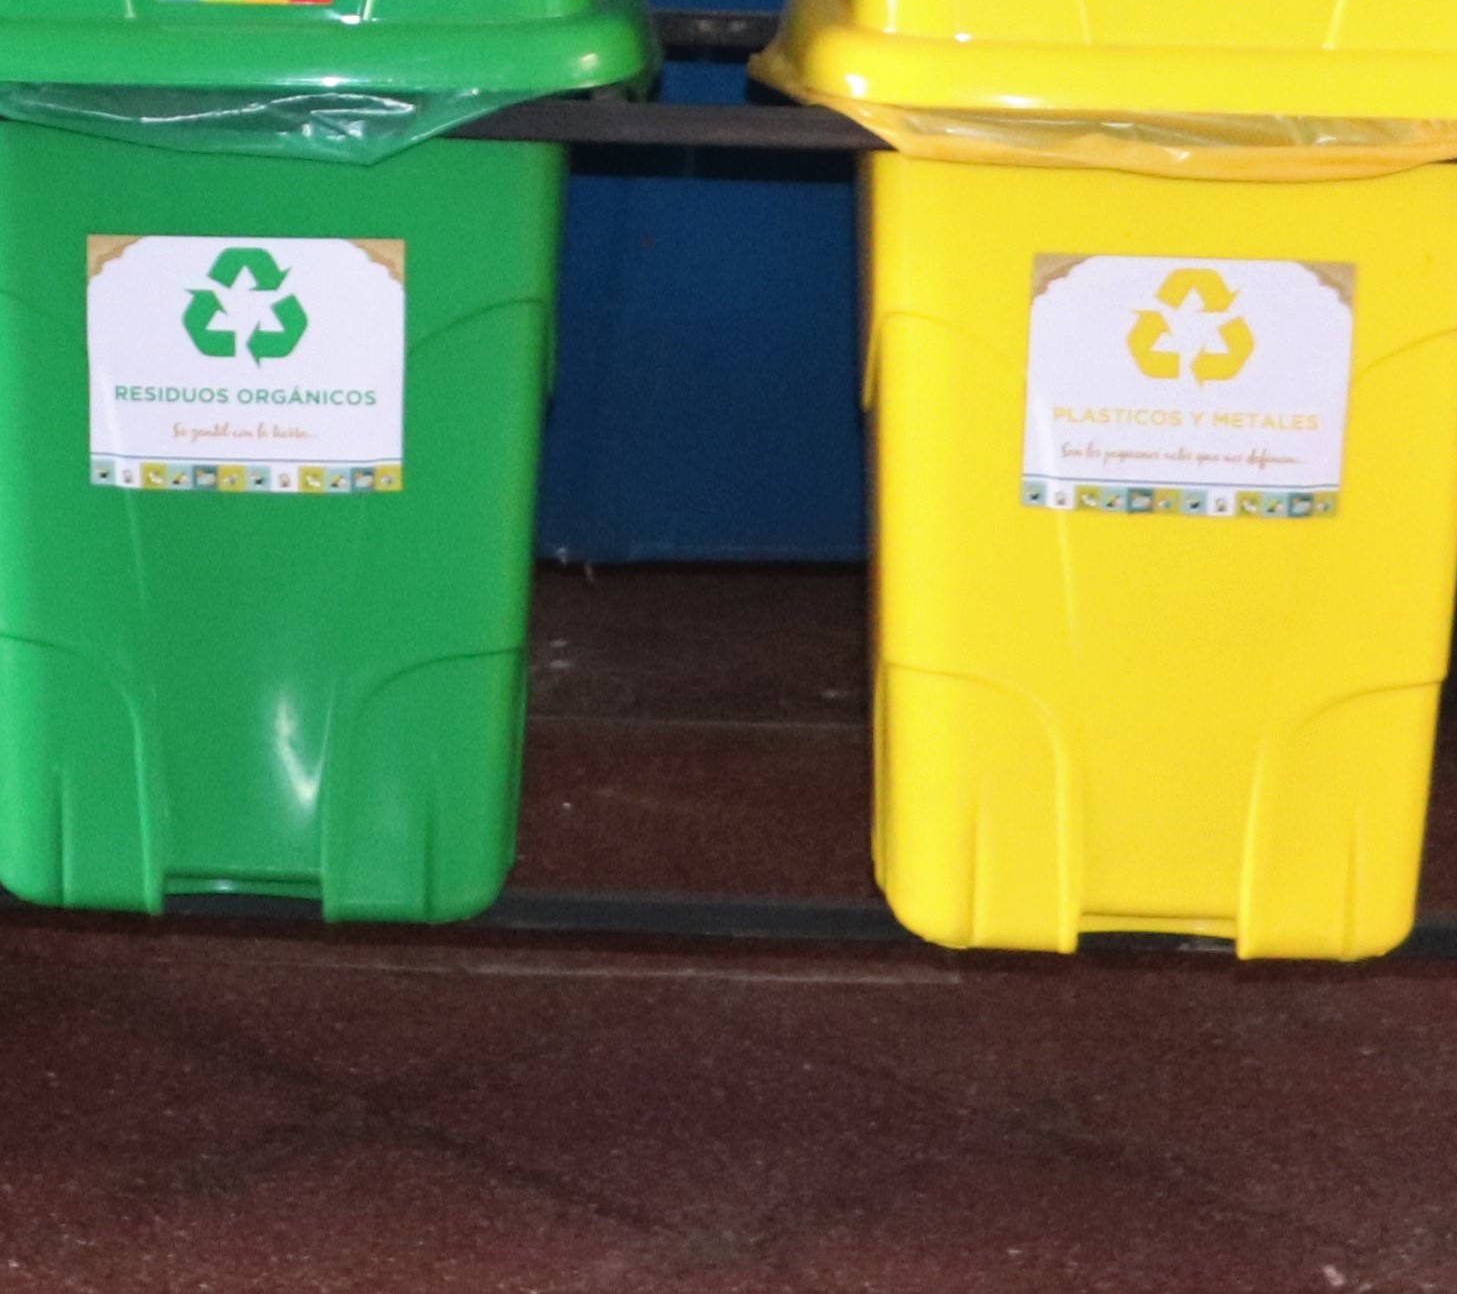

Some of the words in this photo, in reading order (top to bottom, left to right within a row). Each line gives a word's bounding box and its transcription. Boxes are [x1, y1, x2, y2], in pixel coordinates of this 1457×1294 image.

[114, 385, 229, 404] RESIDUOS
[237, 385, 377, 407] ORGÁNICOS
[1052, 406, 1183, 427] PLASTICOS
[1192, 411, 1203, 428] Y
[1212, 413, 1320, 432] METALES
